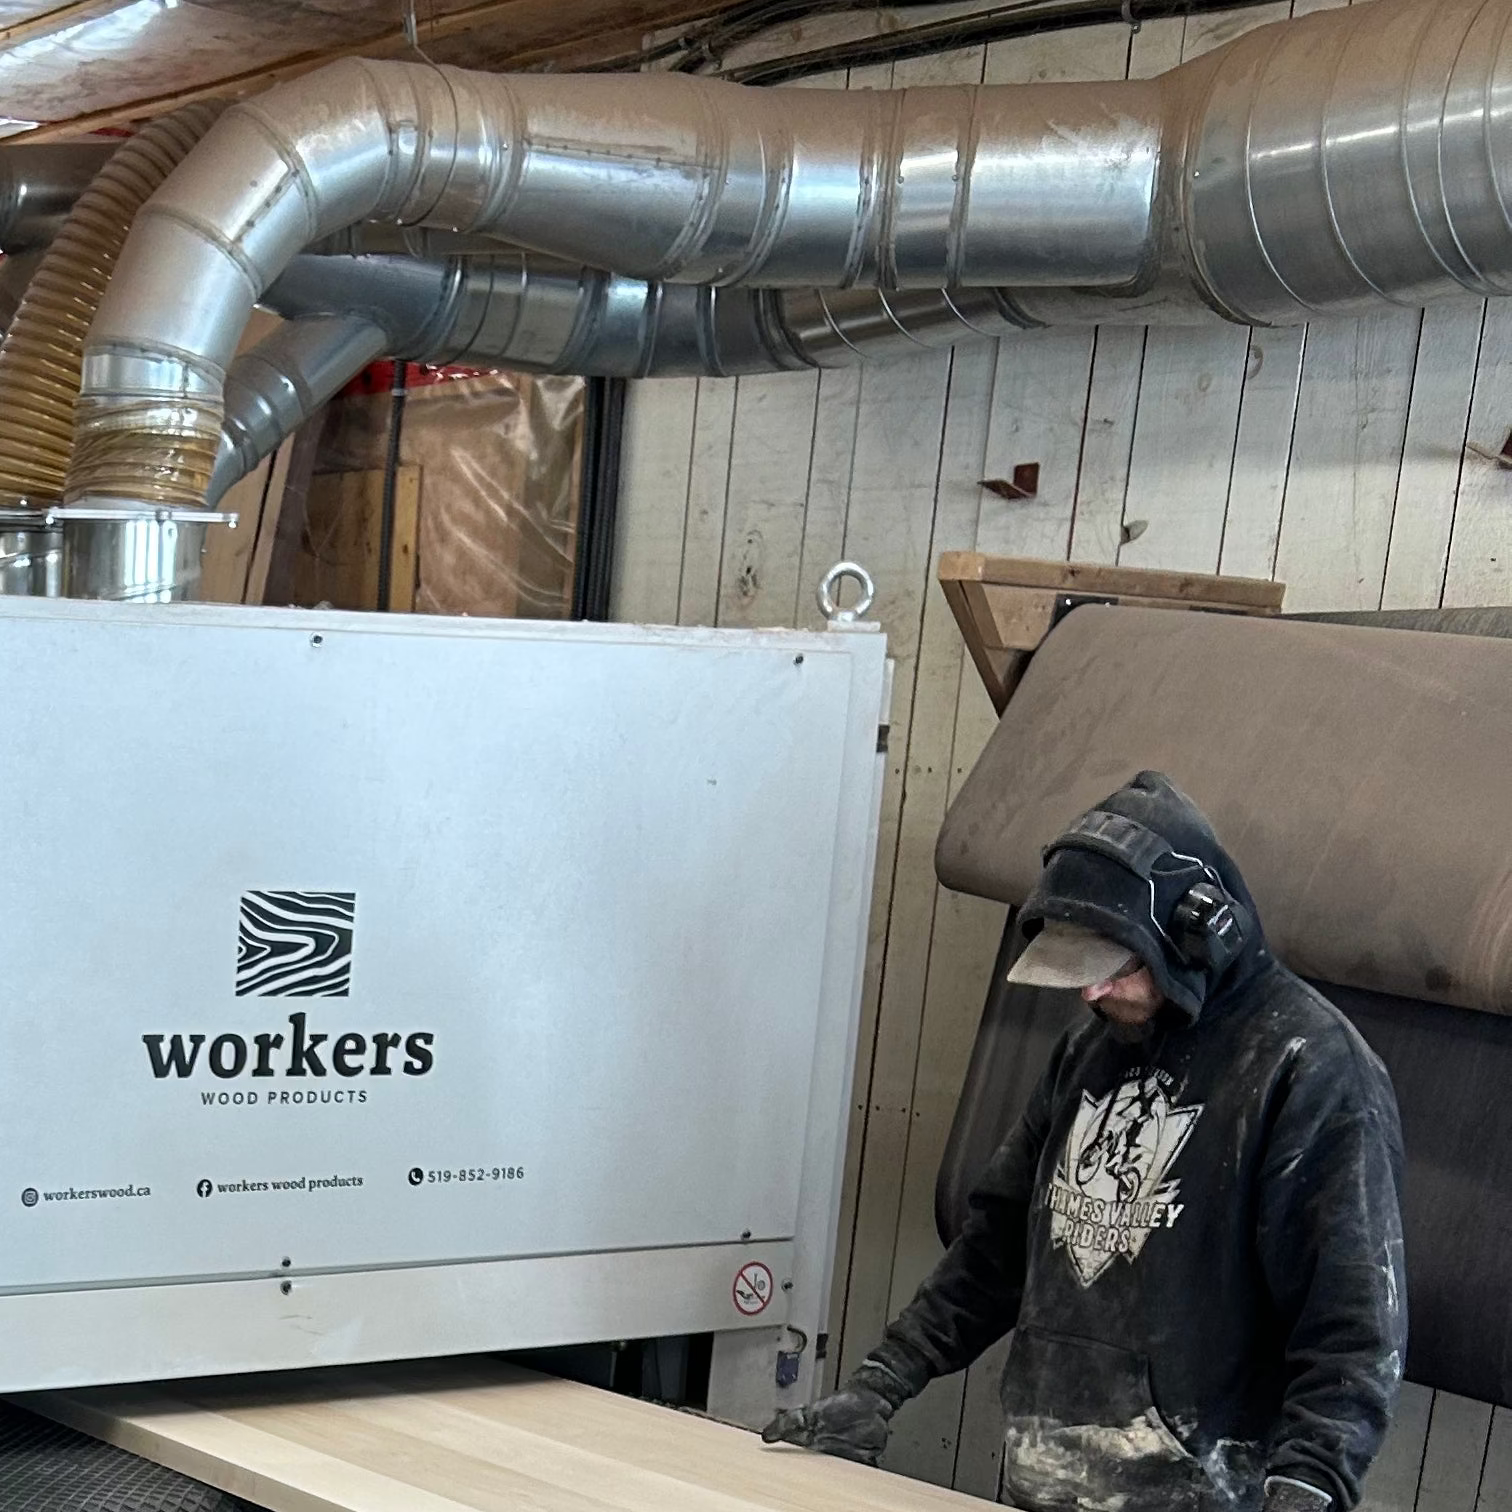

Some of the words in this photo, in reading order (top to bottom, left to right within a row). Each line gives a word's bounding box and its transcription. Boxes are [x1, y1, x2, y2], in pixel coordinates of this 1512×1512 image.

[142, 1011, 434, 1079] workers
[201, 1091, 258, 1105] WOOD
[267, 1089, 368, 1105] PRODUCTS
[217, 1178, 269, 1193] workers
[271, 1176, 306, 1190] wood
[308, 1174, 364, 1191] products
[427, 1166, 524, 1183] 519-852-9186
[43, 1184, 151, 1202] workerswood.ca
[1044, 1182, 1106, 1224] THAMES
[1109, 1201, 1185, 1229] VALLEY
[1063, 1218, 1131, 1253] RIDERS
